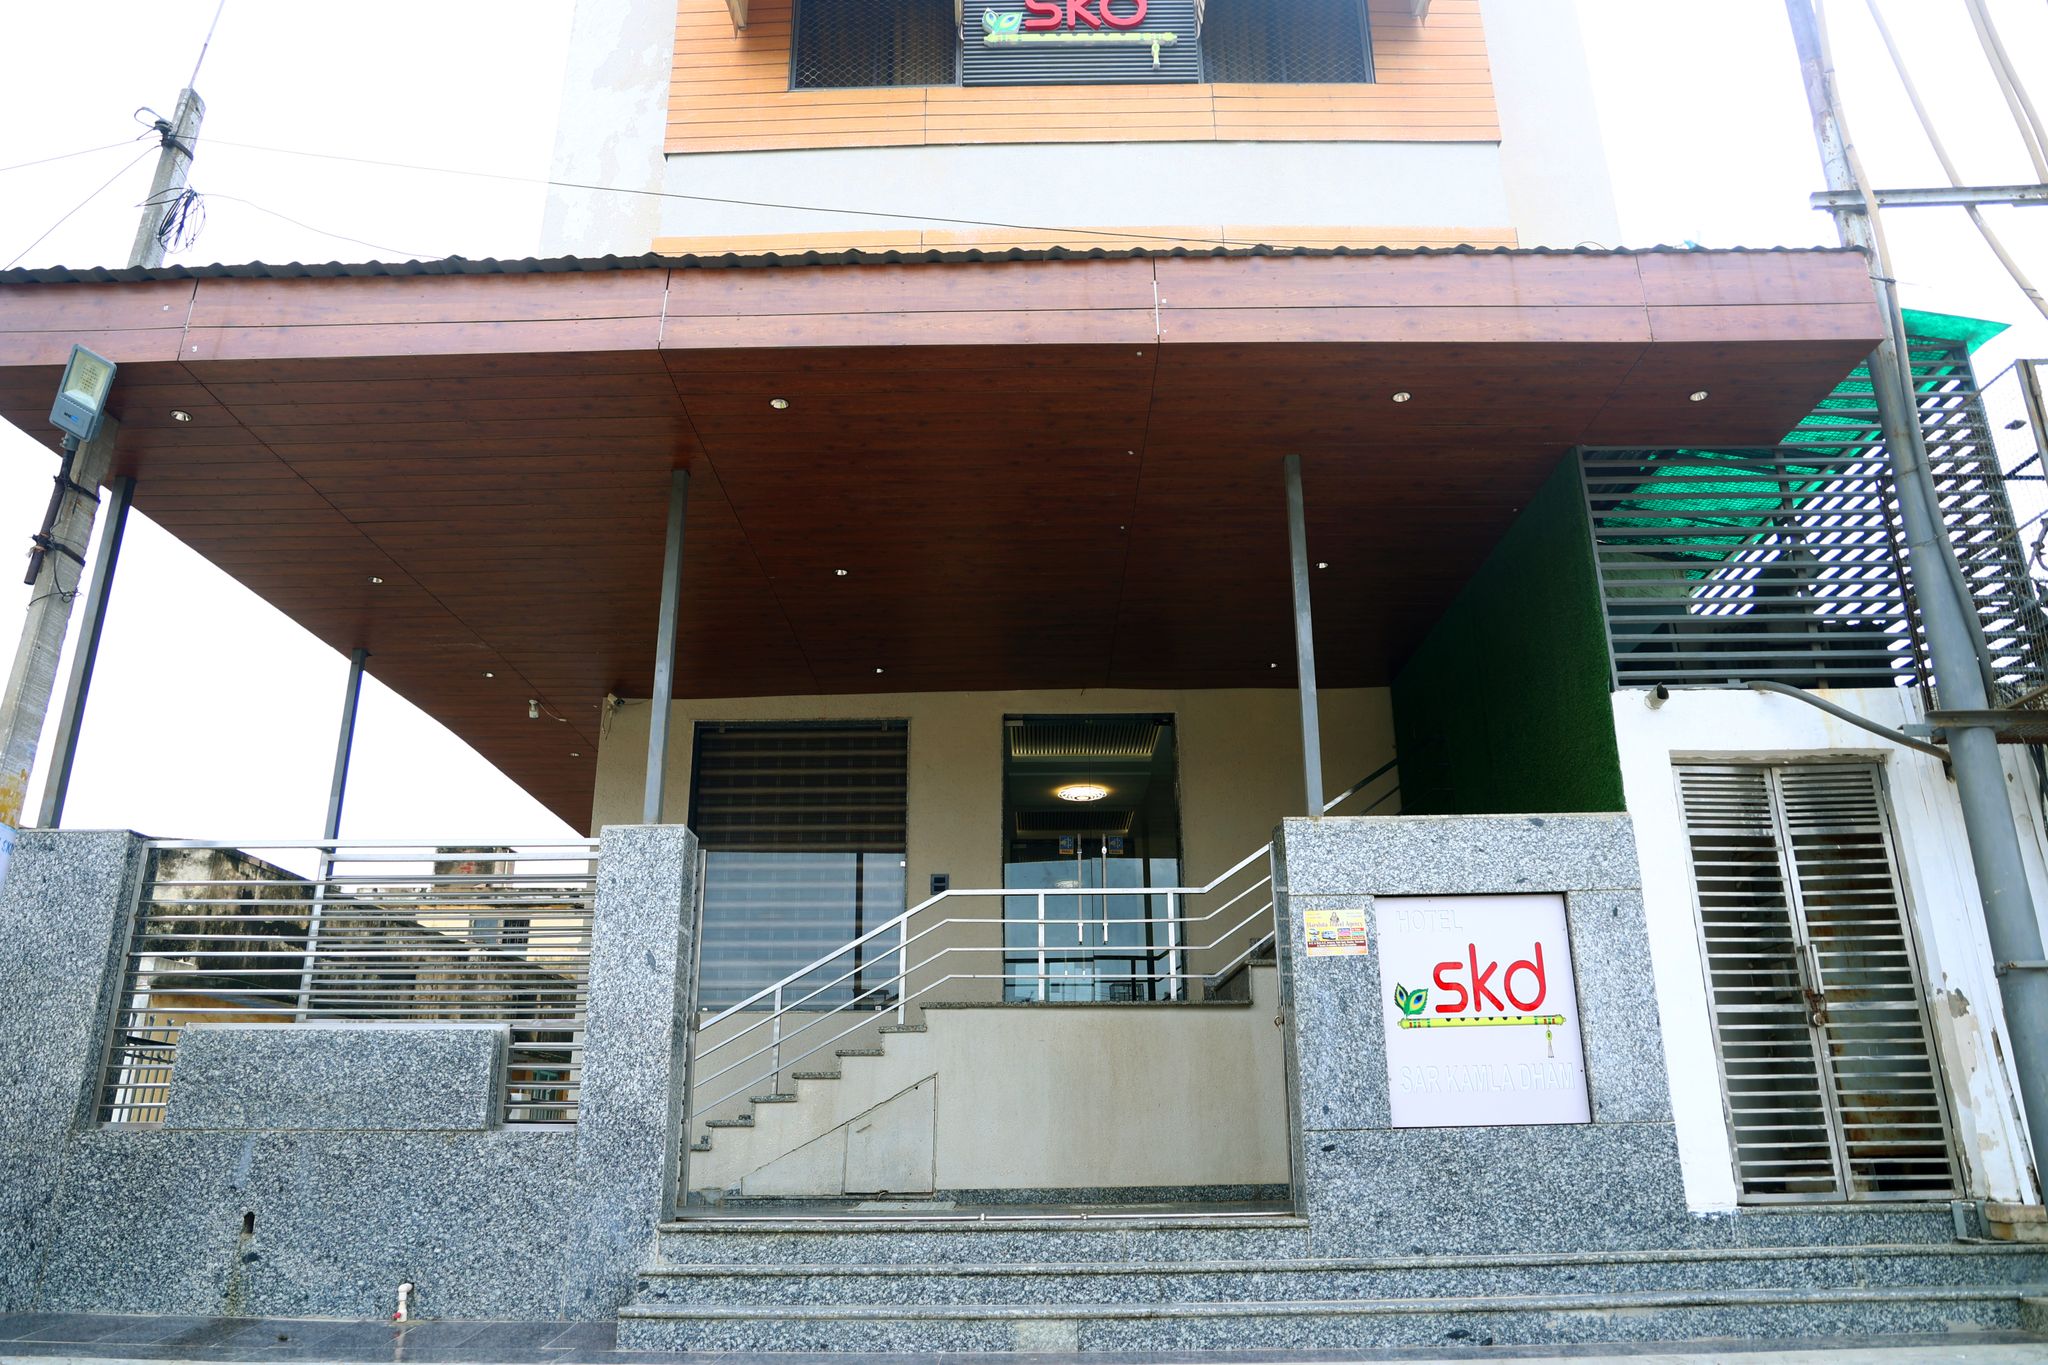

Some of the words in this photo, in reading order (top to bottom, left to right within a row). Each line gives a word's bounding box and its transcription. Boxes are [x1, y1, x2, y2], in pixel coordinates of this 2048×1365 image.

[1395, 908, 1464, 933] HOTEL
[1433, 941, 1546, 1013] skd
[1400, 1065, 1442, 1094] SAR
[1446, 1063, 1516, 1094] KAMLA
[1518, 1062, 1576, 1092] DHAM
